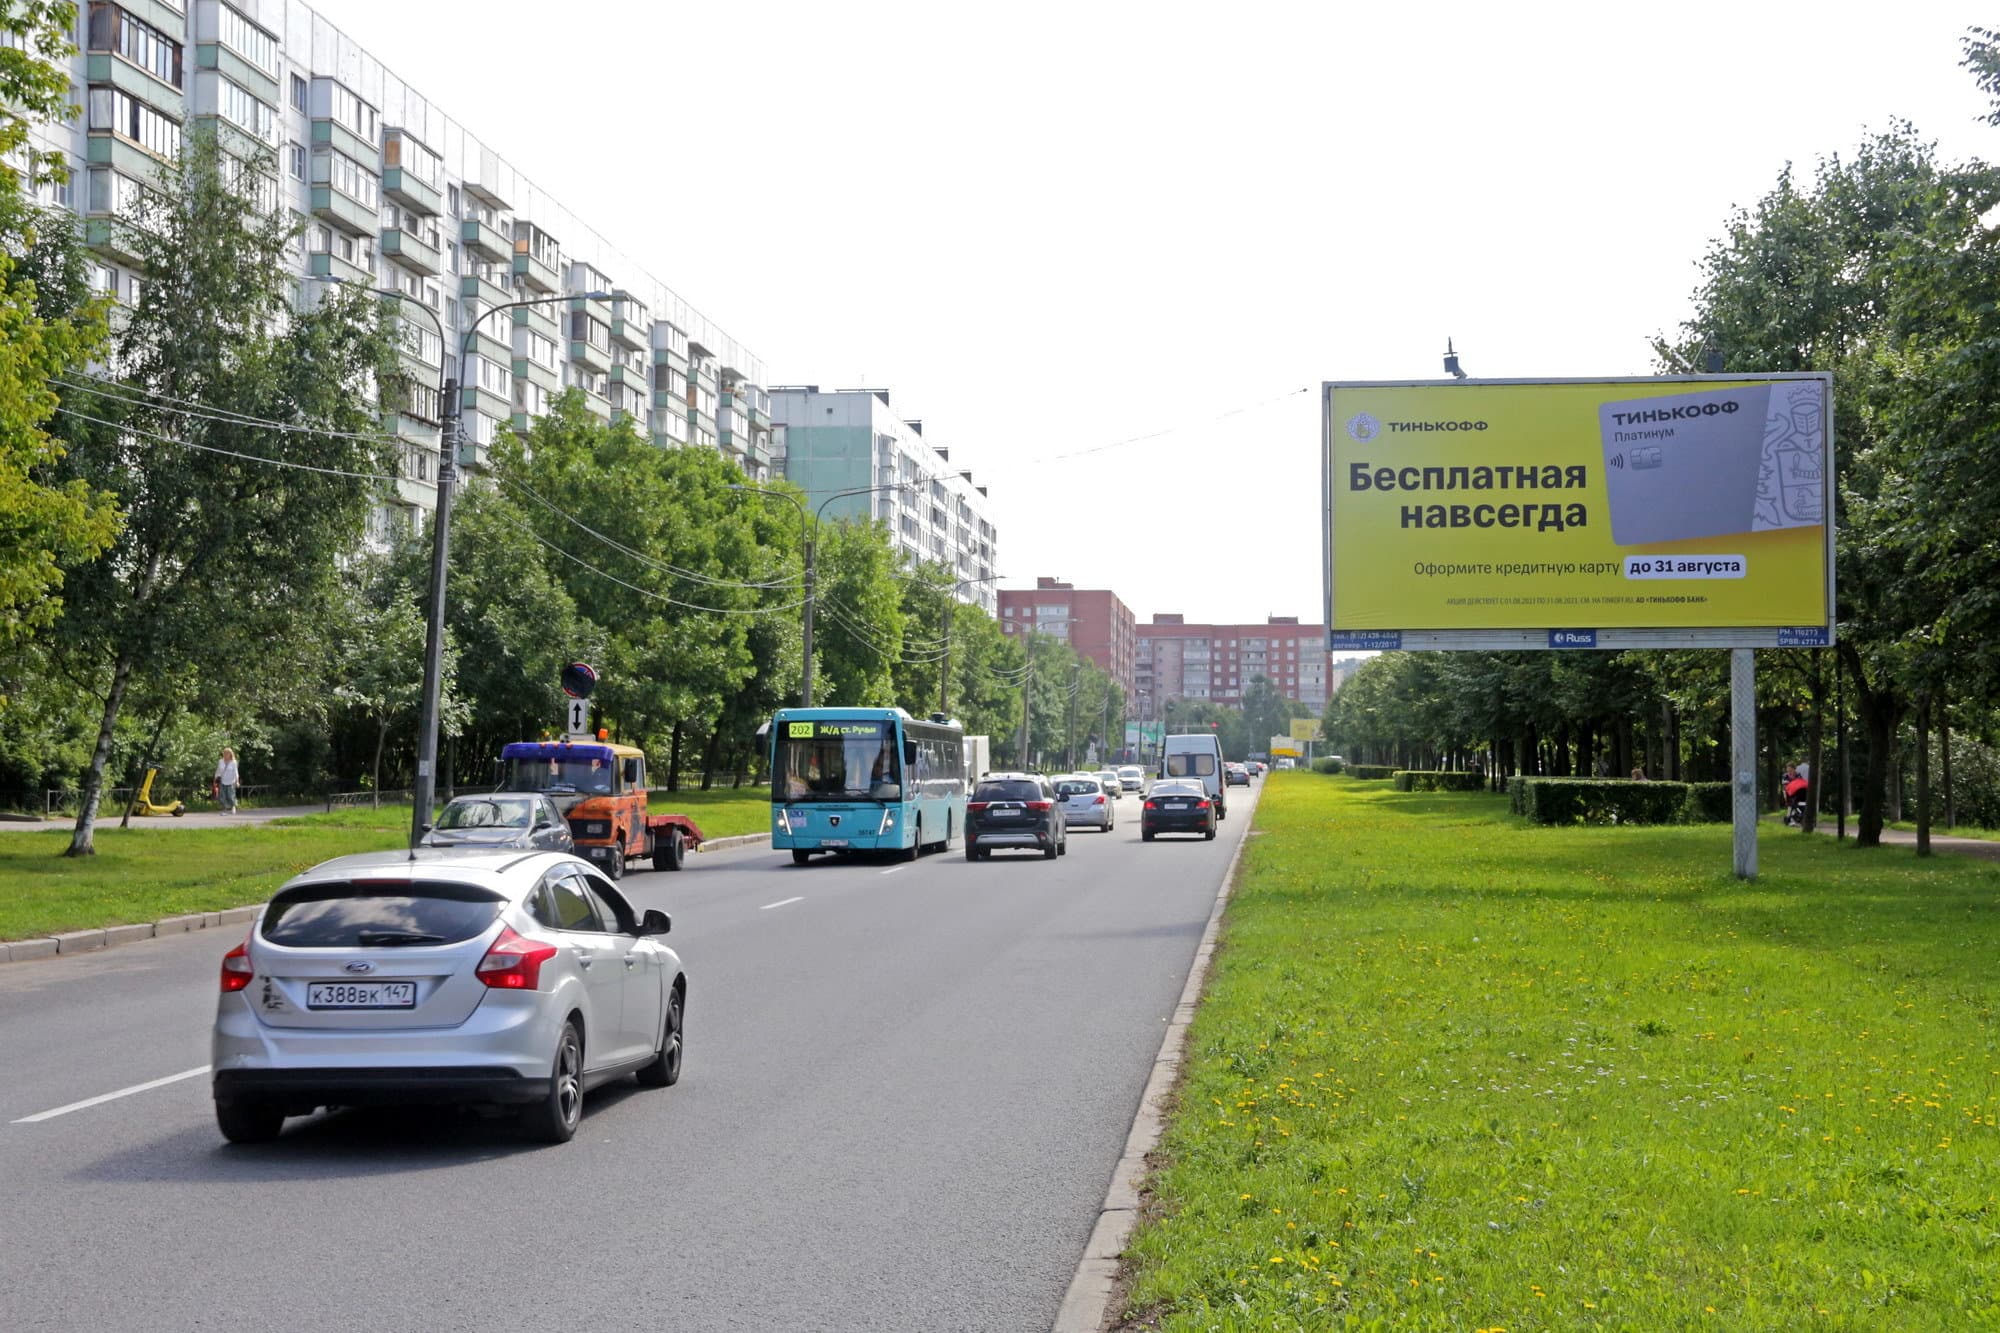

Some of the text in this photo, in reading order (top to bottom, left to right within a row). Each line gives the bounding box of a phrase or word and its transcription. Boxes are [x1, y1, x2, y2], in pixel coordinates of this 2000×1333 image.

[1611, 401, 1740, 426] ТИНЬКОФФ
[1388, 420, 1489, 432] ТИНЬКОФФ
[1614, 428, 1675, 442] Платинум
[1350, 462, 1587, 491] Бесплатная
[1400, 502, 1588, 532] навсегда
[1414, 560, 1741, 578] Оформите кредитную карту до 31 августа
[1566, 633, 1592, 643] Russ
[790, 725, 811, 735] 202
[383, 985, 411, 999] 147
